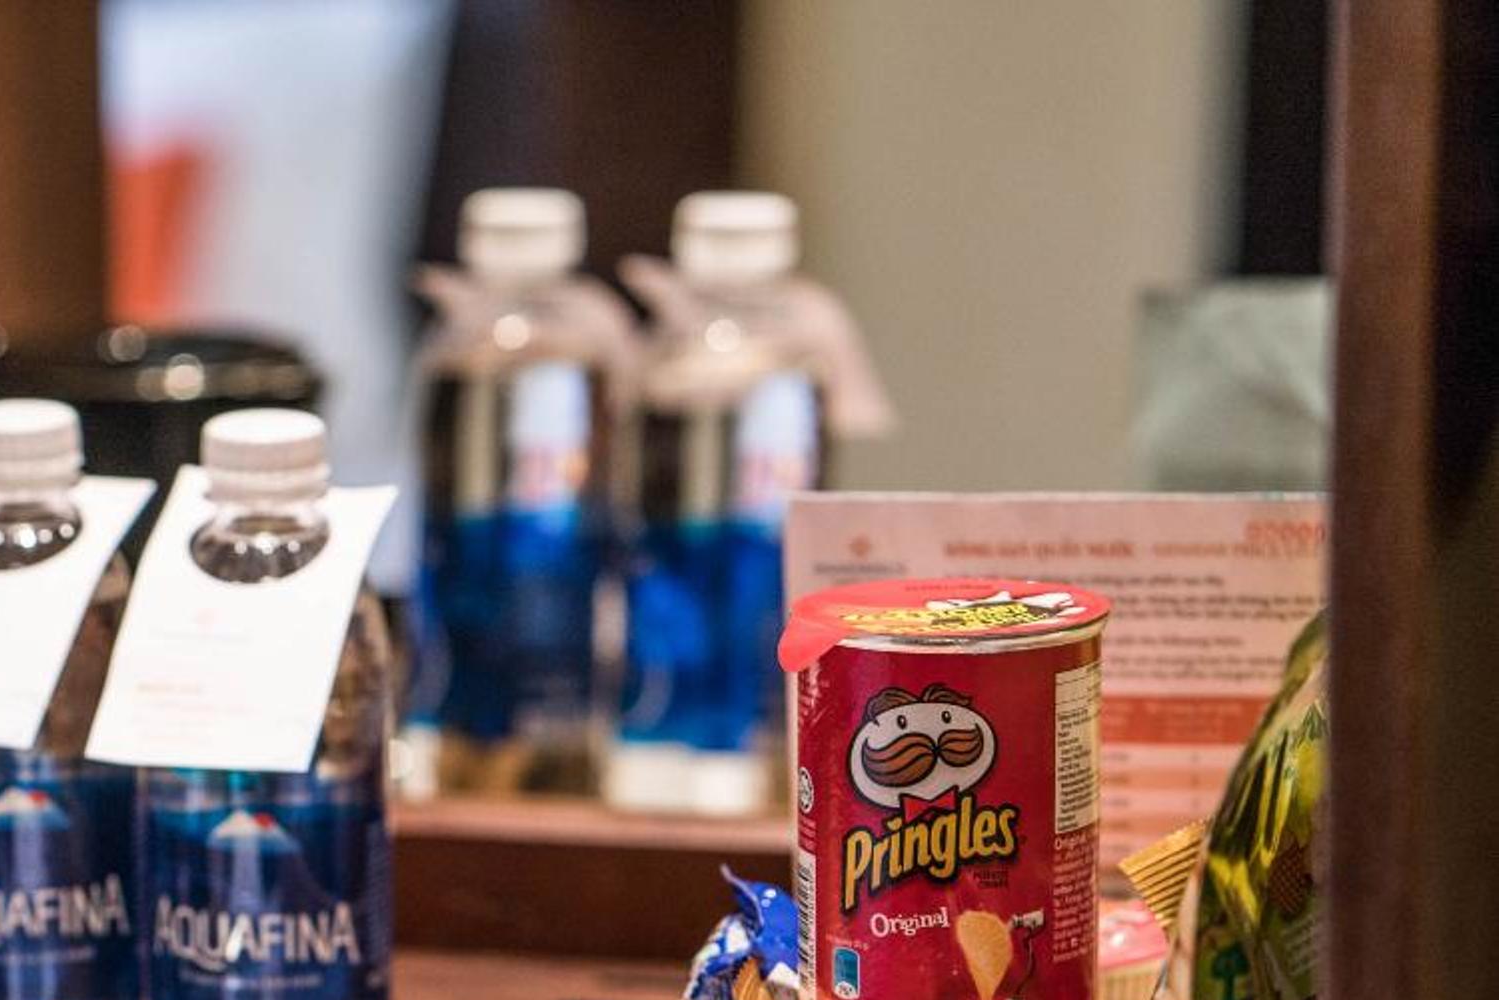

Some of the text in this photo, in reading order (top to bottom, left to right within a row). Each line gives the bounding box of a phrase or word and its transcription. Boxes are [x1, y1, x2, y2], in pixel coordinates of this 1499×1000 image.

[843, 793, 1017, 912] Pringles
[154, 895, 361, 971] AQUAFINA
[870, 906, 950, 937] Original
